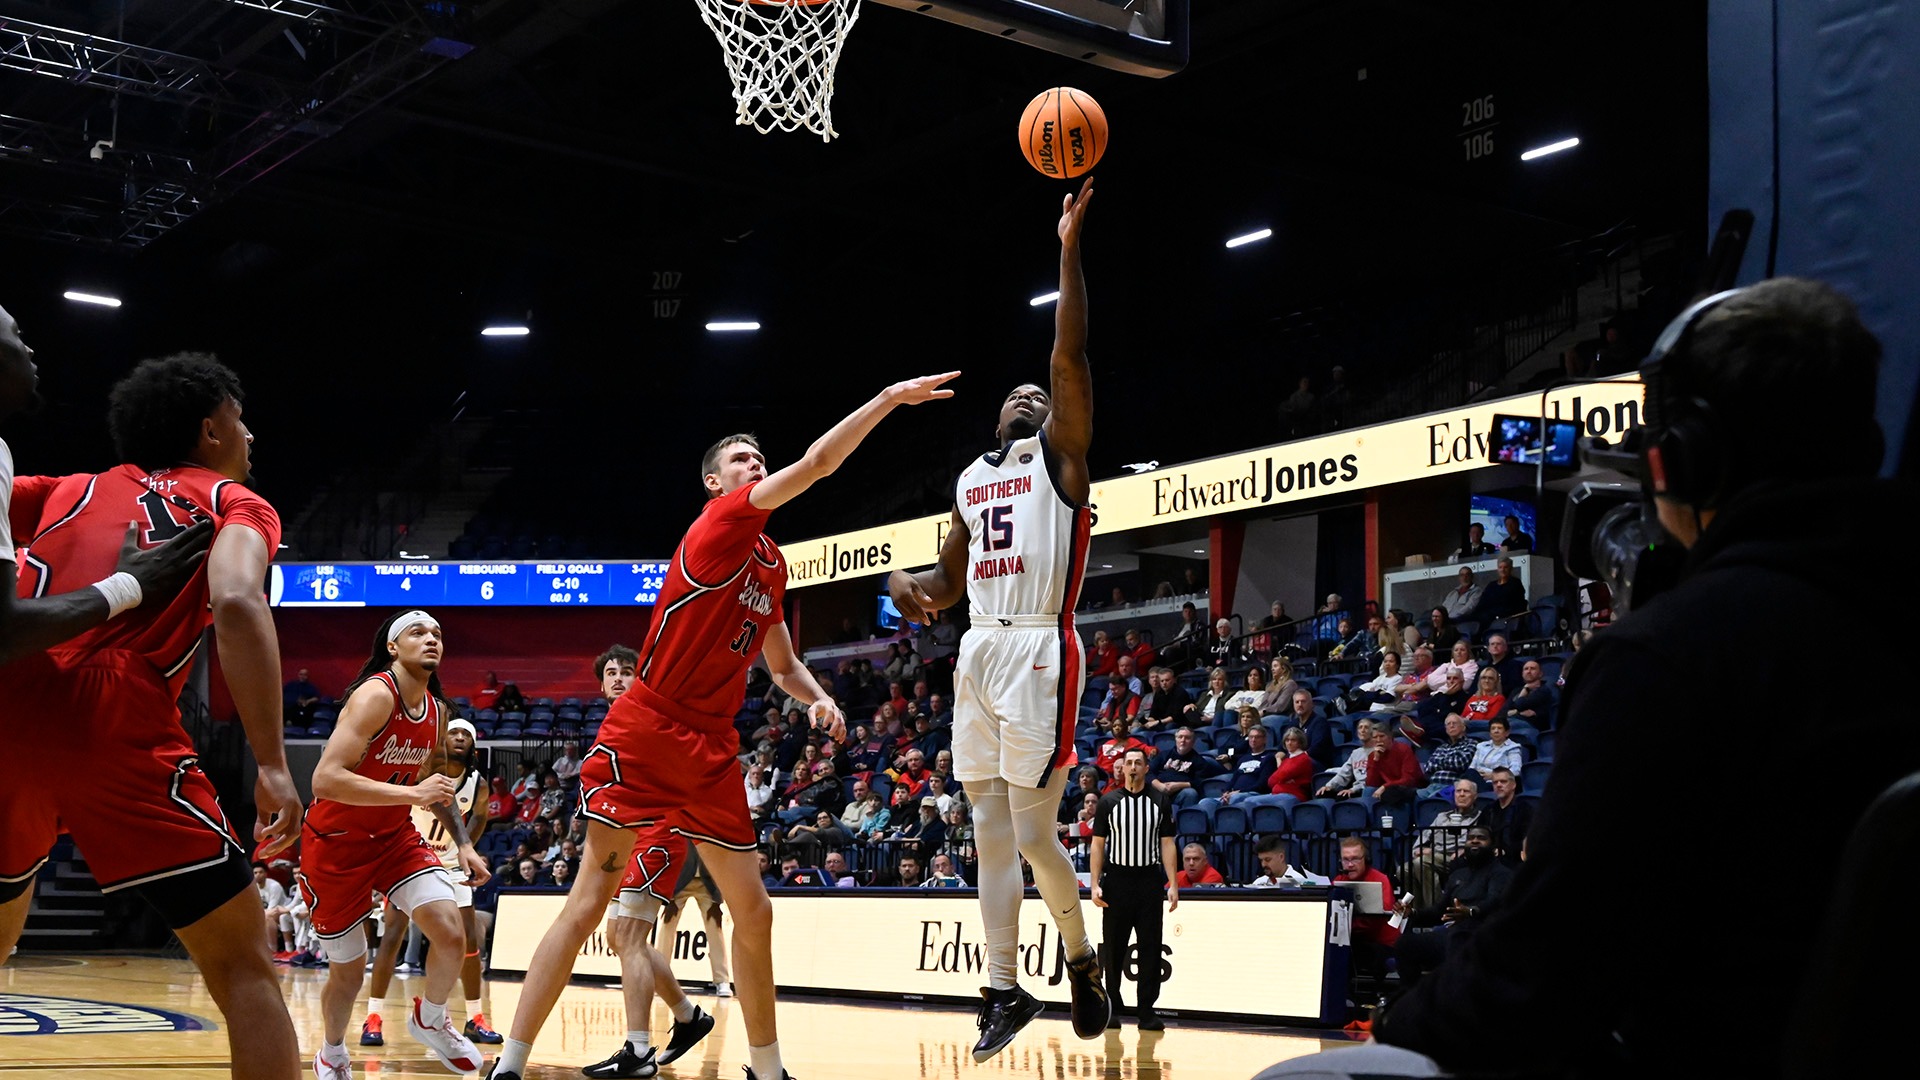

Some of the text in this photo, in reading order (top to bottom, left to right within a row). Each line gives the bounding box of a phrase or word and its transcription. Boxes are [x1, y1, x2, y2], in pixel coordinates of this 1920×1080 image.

[1462, 94, 1495, 127] 206
[1039, 121, 1058, 175] Wilson
[1069, 126, 1085, 168] NCAA
[1464, 130, 1494, 161] 106
[652, 271, 682, 290] 207
[653, 299, 682, 319] 107
[1426, 418, 1491, 467] Edw
[966, 475, 1032, 508] SOUTHERN
[1152, 460, 1259, 517] Edward
[1261, 454, 1359, 503] Jones
[980, 504, 1014, 552] 15
[316, 565, 334, 576] USI
[374, 565, 440, 575] TEAM FOULS
[459, 564, 517, 575] REBOUNDS
[536, 564, 604, 575] FIELD GOALS
[631, 563, 657, 574] 3-PT.
[787, 543, 892, 581] ward Jones
[310, 577, 340, 600] 16
[400, 577, 412, 592] 4
[480, 581, 495, 601] 6
[552, 577, 580, 590] 6-10
[642, 576, 664, 590] 2-5
[550, 593, 589, 603] 60.0 %
[634, 592, 657, 603] 40.0
[1352, 760, 1368, 770] US
[915, 920, 1048, 978] Edwd
